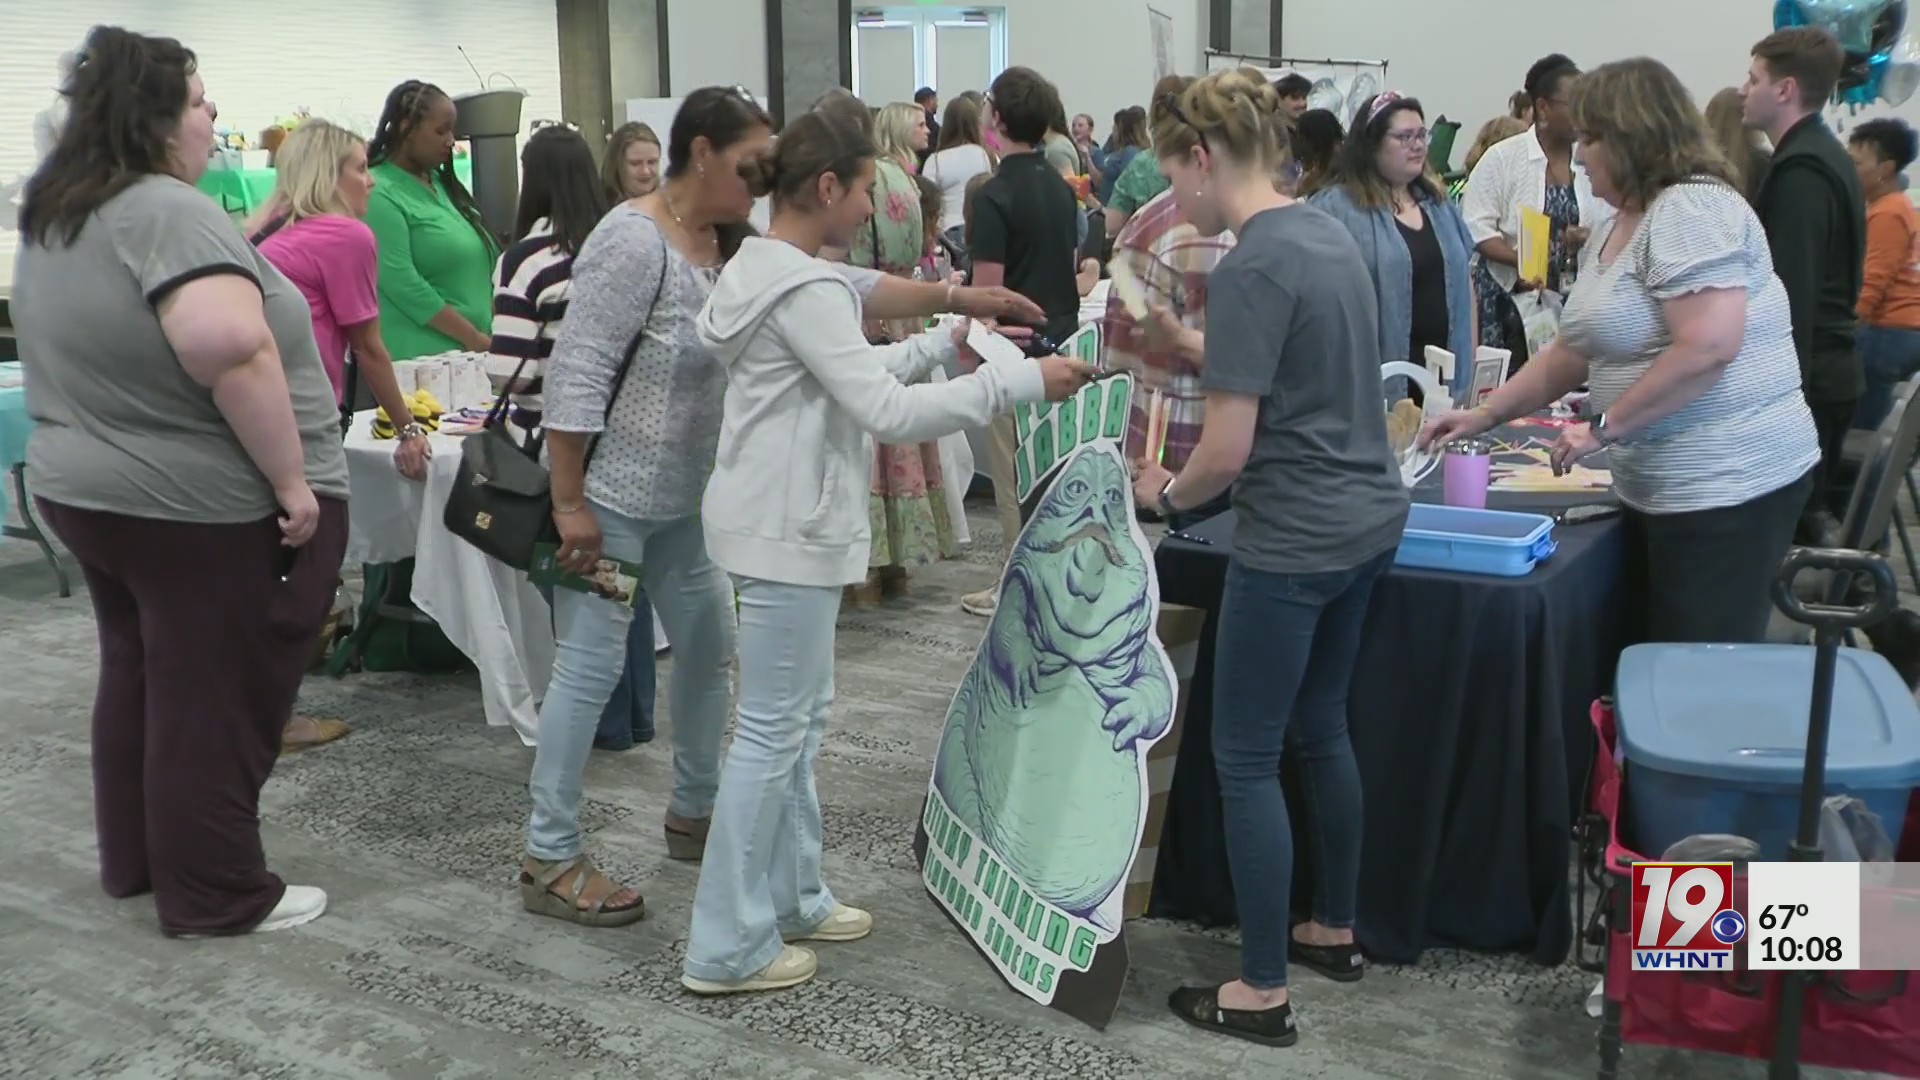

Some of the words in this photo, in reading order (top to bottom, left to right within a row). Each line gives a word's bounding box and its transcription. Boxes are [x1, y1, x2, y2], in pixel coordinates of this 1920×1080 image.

[923, 847, 984, 931] FLAVORED
[984, 915, 1056, 994] SNACKS
[924, 791, 972, 870] STINKY
[974, 847, 1097, 969] THINKING
